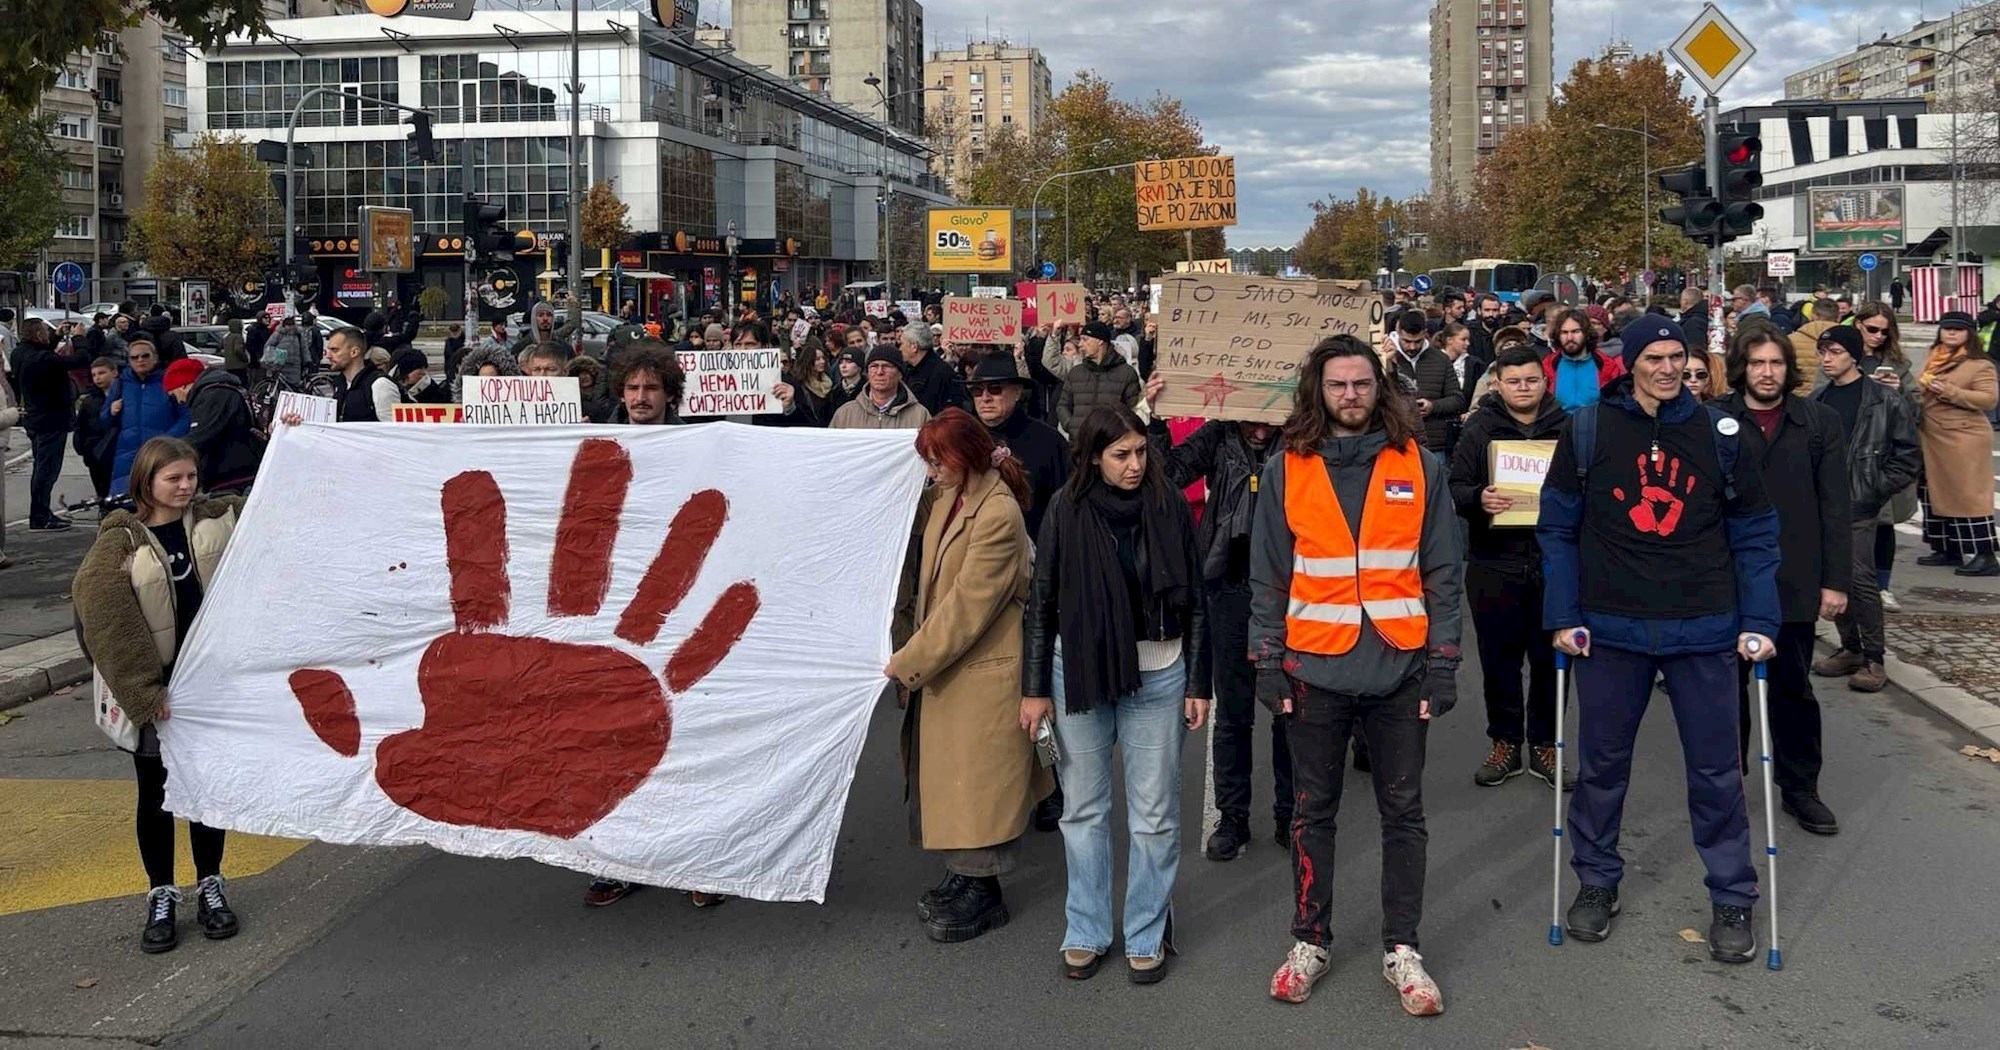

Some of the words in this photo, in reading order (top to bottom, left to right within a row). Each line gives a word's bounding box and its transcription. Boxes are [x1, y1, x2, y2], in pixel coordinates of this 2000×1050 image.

[1136, 163, 1155, 182] NE
[1160, 161, 1174, 180] BI
[1178, 159, 1208, 178] BILO
[1211, 158, 1235, 178] OVE
[1137, 185, 1164, 202] KRVI
[1167, 182, 1186, 201] DA
[1188, 181, 1204, 198] JE
[1208, 180, 1236, 198] BILO
[950, 212, 989, 226] Glovo
[1138, 205, 1165, 226] SVE
[1168, 203, 1185, 222] PO
[1189, 202, 1236, 221] ZAKONU
[938, 232, 971, 247] 50%
[1047, 291, 1057, 317] 1
[1167, 278, 1216, 302] TO
[1236, 284, 1296, 303] SMO
[1316, 293, 1368, 311] MOGLI
[950, 302, 988, 315] RUKE
[993, 305, 1011, 315] SU
[968, 317, 990, 327] VAM
[1172, 309, 1218, 323] BITI
[1243, 312, 1271, 328] MI,
[1283, 312, 1310, 327] SVI
[1320, 317, 1359, 335] SMO
[950, 326, 1001, 341] KRVAVE
[1169, 336, 1196, 348] MI
[1229, 336, 1273, 350] POD
[677, 353, 697, 372] БЕЗ
[700, 351, 779, 371] ОДГОВОРНОСТИ
[480, 378, 556, 403] КОРУПЦИЈА
[699, 374, 737, 392] НЕМА
[741, 373, 760, 391] НИ
[520, 403, 529, 423] А
[535, 403, 582, 423] НАРОД
